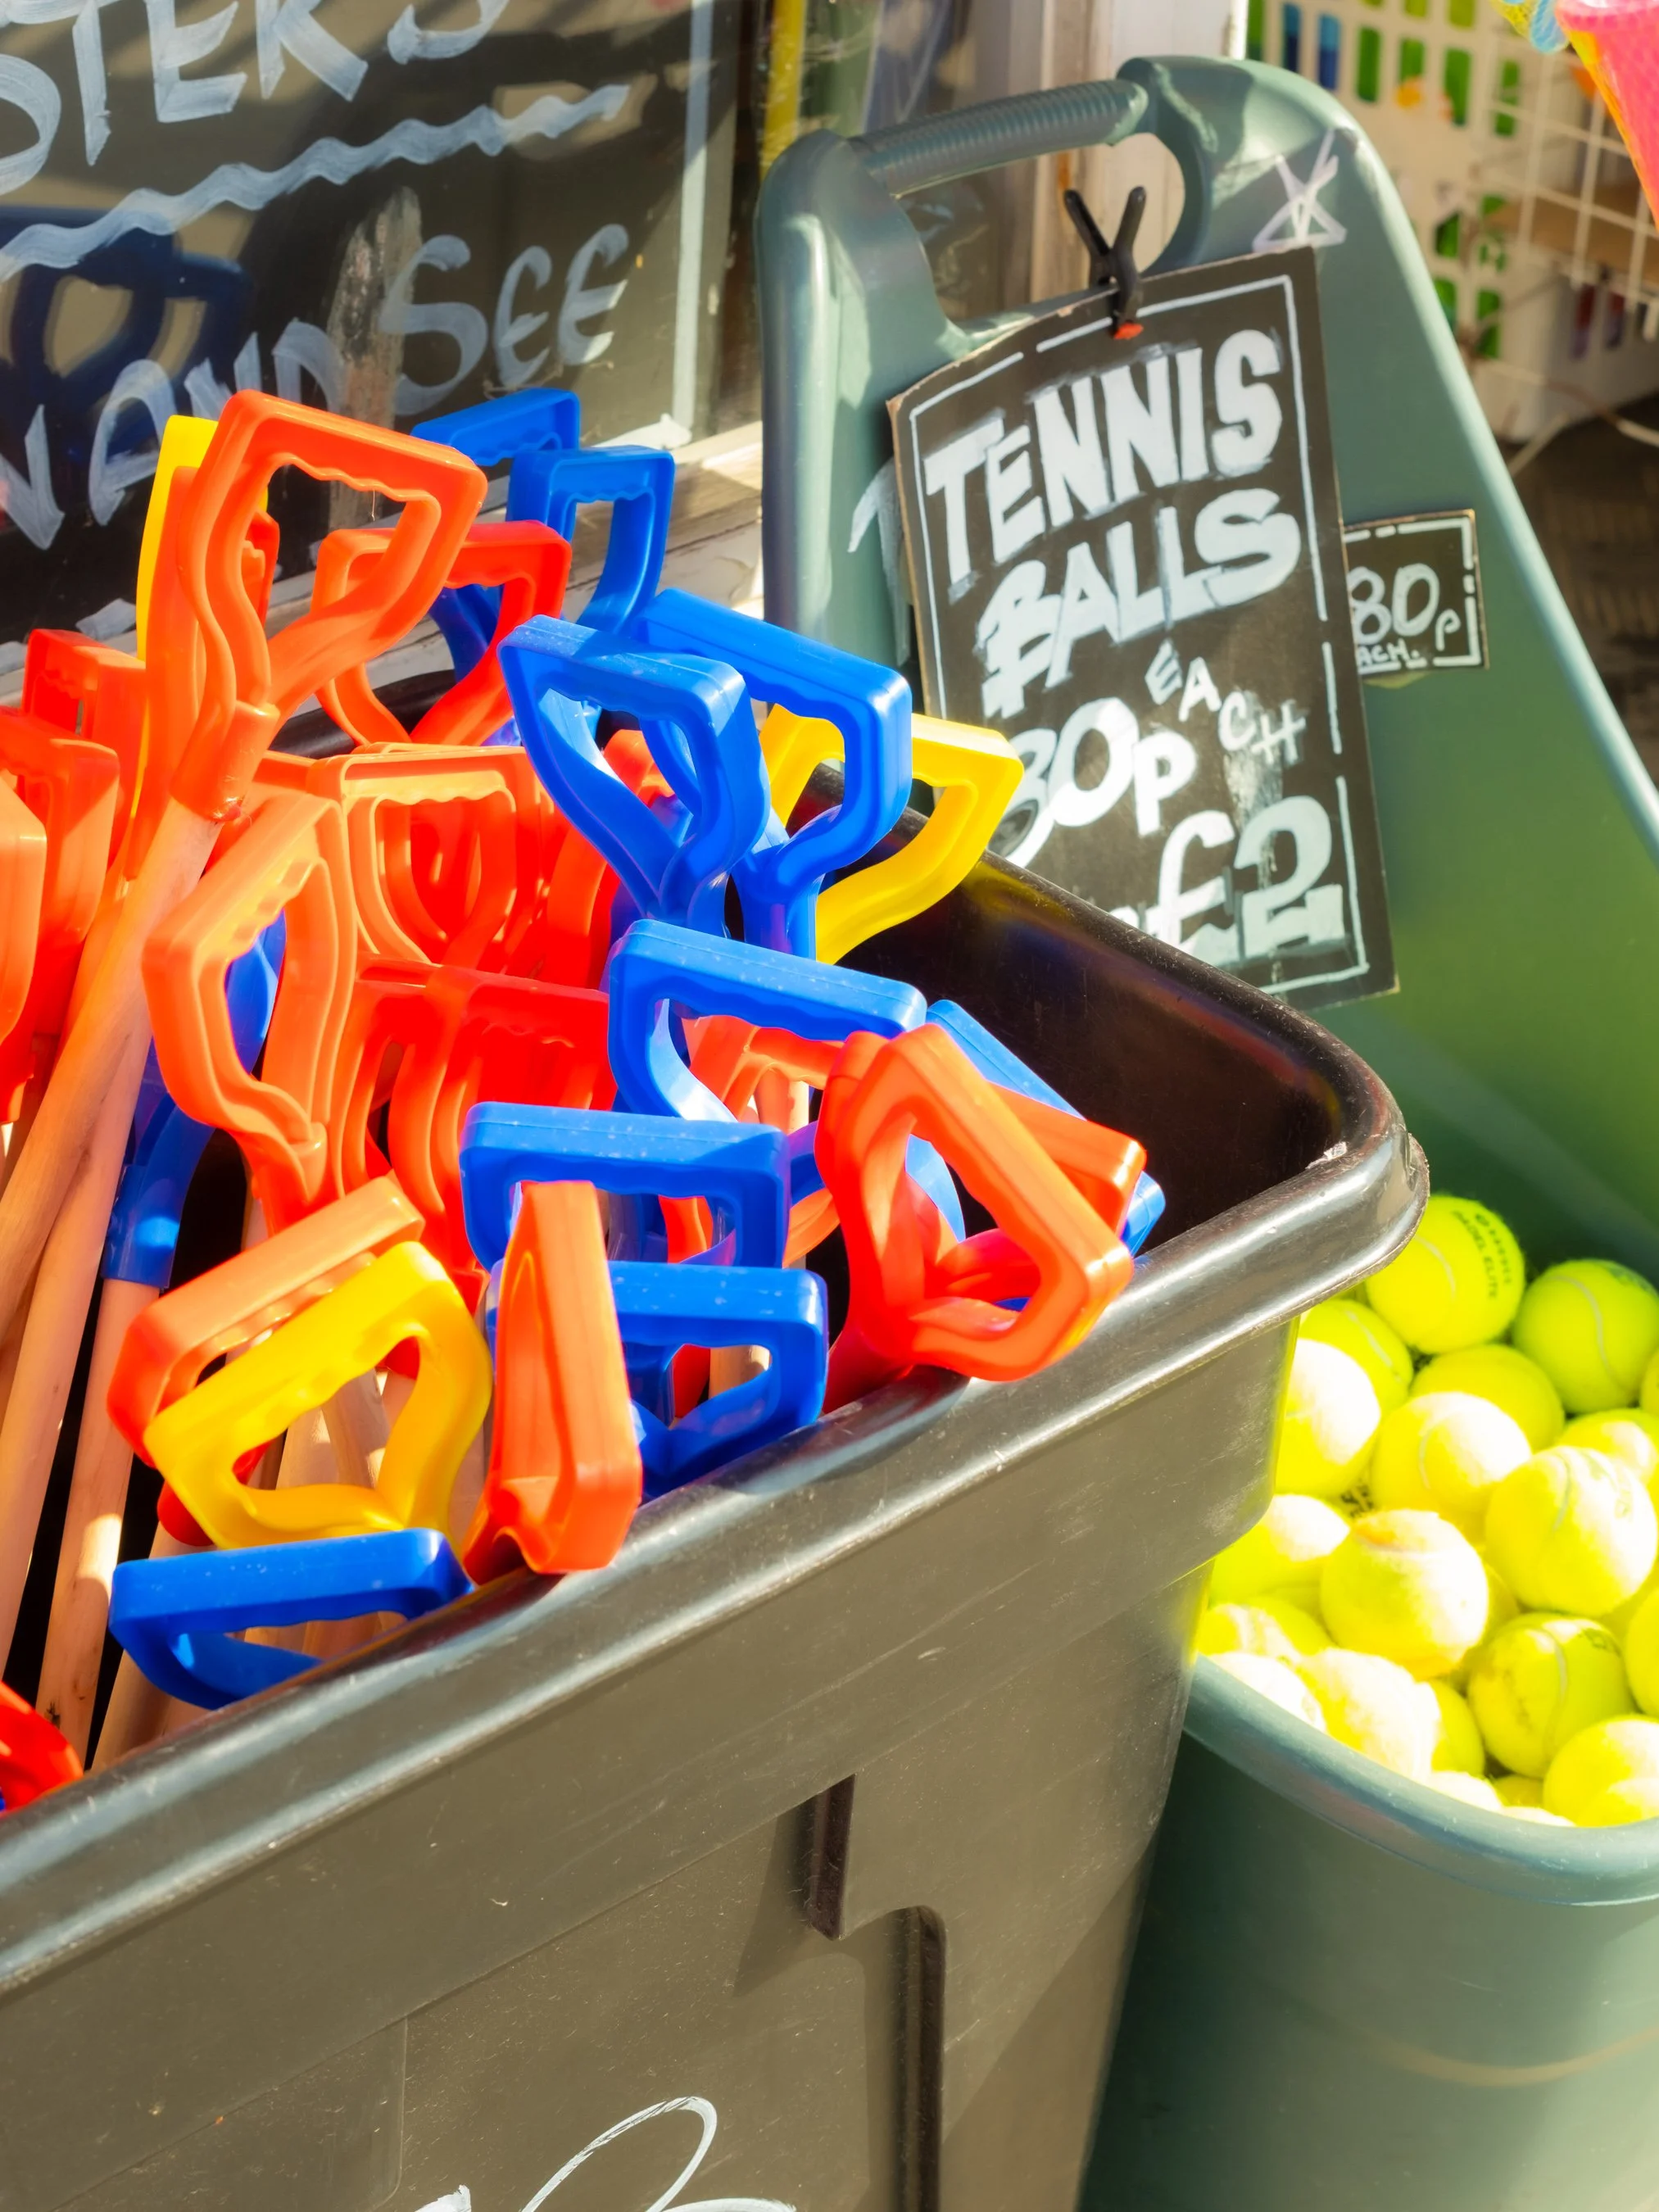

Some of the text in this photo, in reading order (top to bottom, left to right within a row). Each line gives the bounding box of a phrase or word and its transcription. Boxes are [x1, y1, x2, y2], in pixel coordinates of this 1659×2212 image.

[378, 224, 628, 415] SEE
[923, 330, 1282, 596] TENNIS
[977, 488, 1301, 718] BALLS
[1358, 638, 1420, 666] ACH.
[1145, 640, 1306, 766] EACH
[1145, 795, 1345, 967] £2
